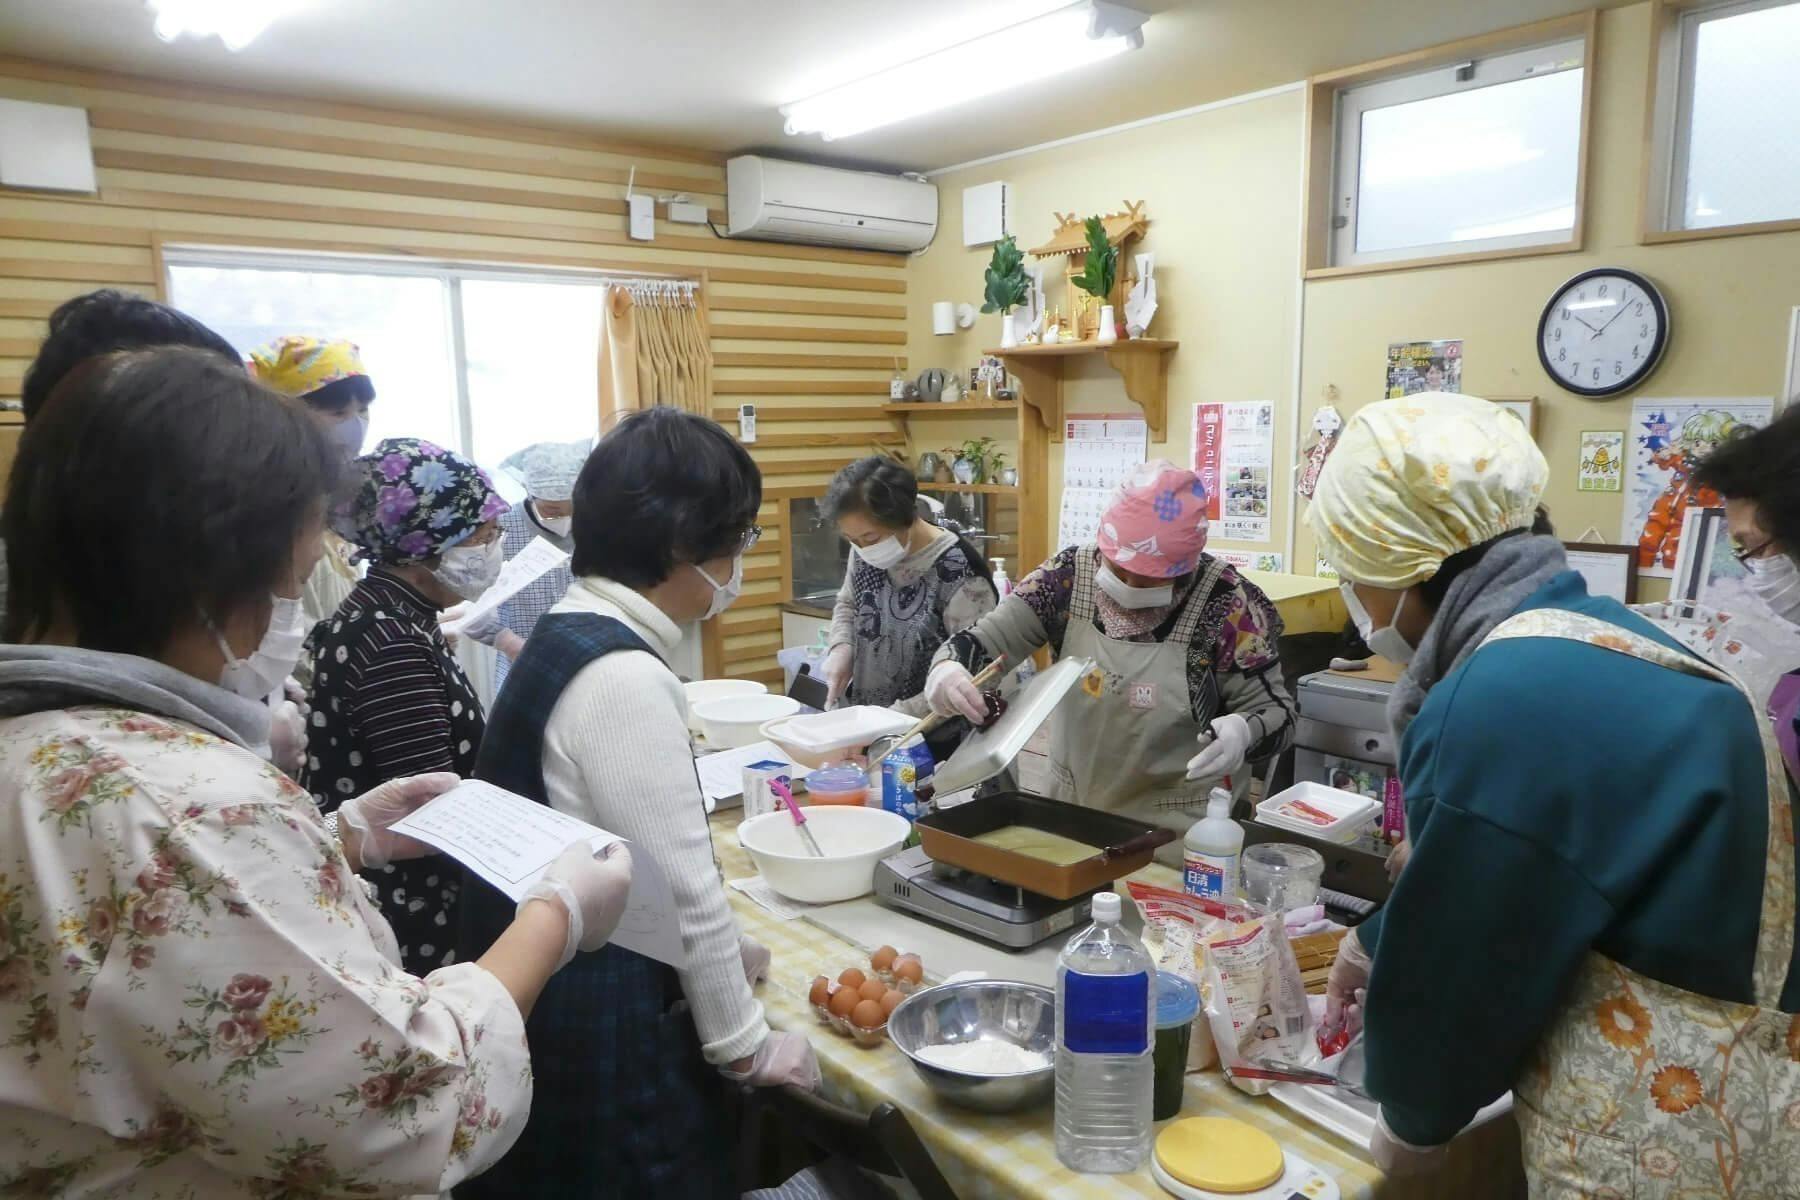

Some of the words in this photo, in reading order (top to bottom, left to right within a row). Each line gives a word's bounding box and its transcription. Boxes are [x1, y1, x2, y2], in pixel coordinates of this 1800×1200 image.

[1598, 284, 1608, 299] 12
[1635, 302, 1643, 317] 2
[1554, 328, 1562, 342] 9
[1640, 324, 1648, 338] 3
[1559, 348, 1566, 361] 8
[1632, 345, 1639, 359] 4
[1572, 362, 1580, 376] 7
[1593, 367, 1600, 380] 6
[1614, 361, 1623, 375] 5
[1187, 870, 1209, 887] 日清
